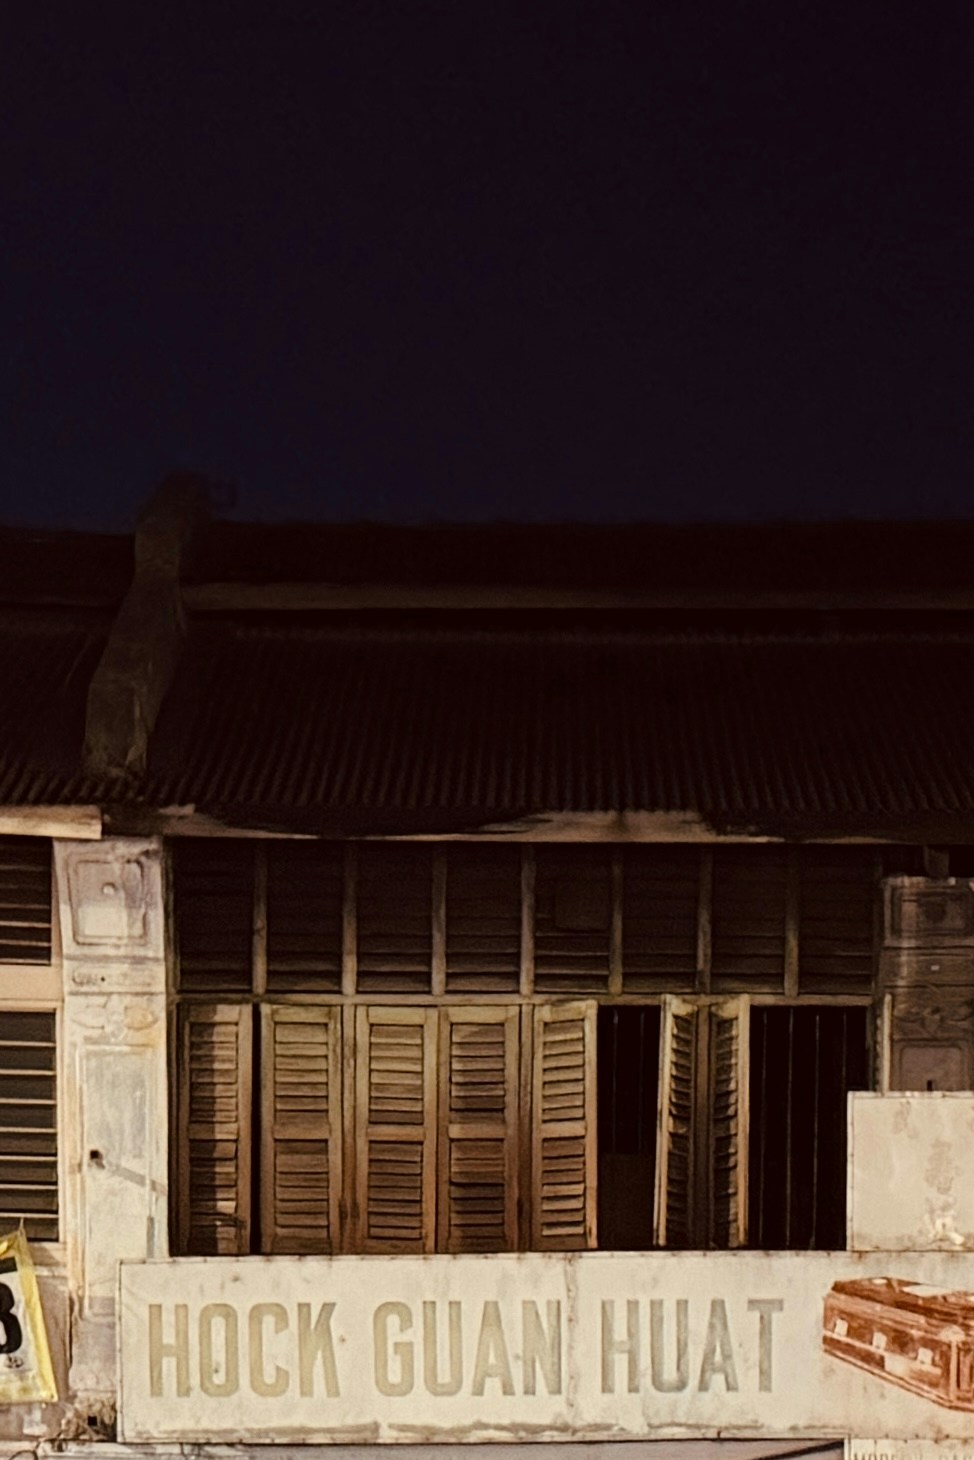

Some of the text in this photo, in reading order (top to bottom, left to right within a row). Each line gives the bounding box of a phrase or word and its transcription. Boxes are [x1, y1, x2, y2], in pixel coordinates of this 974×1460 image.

[147, 1298, 784, 1398] HOCK GUAN HUAT
